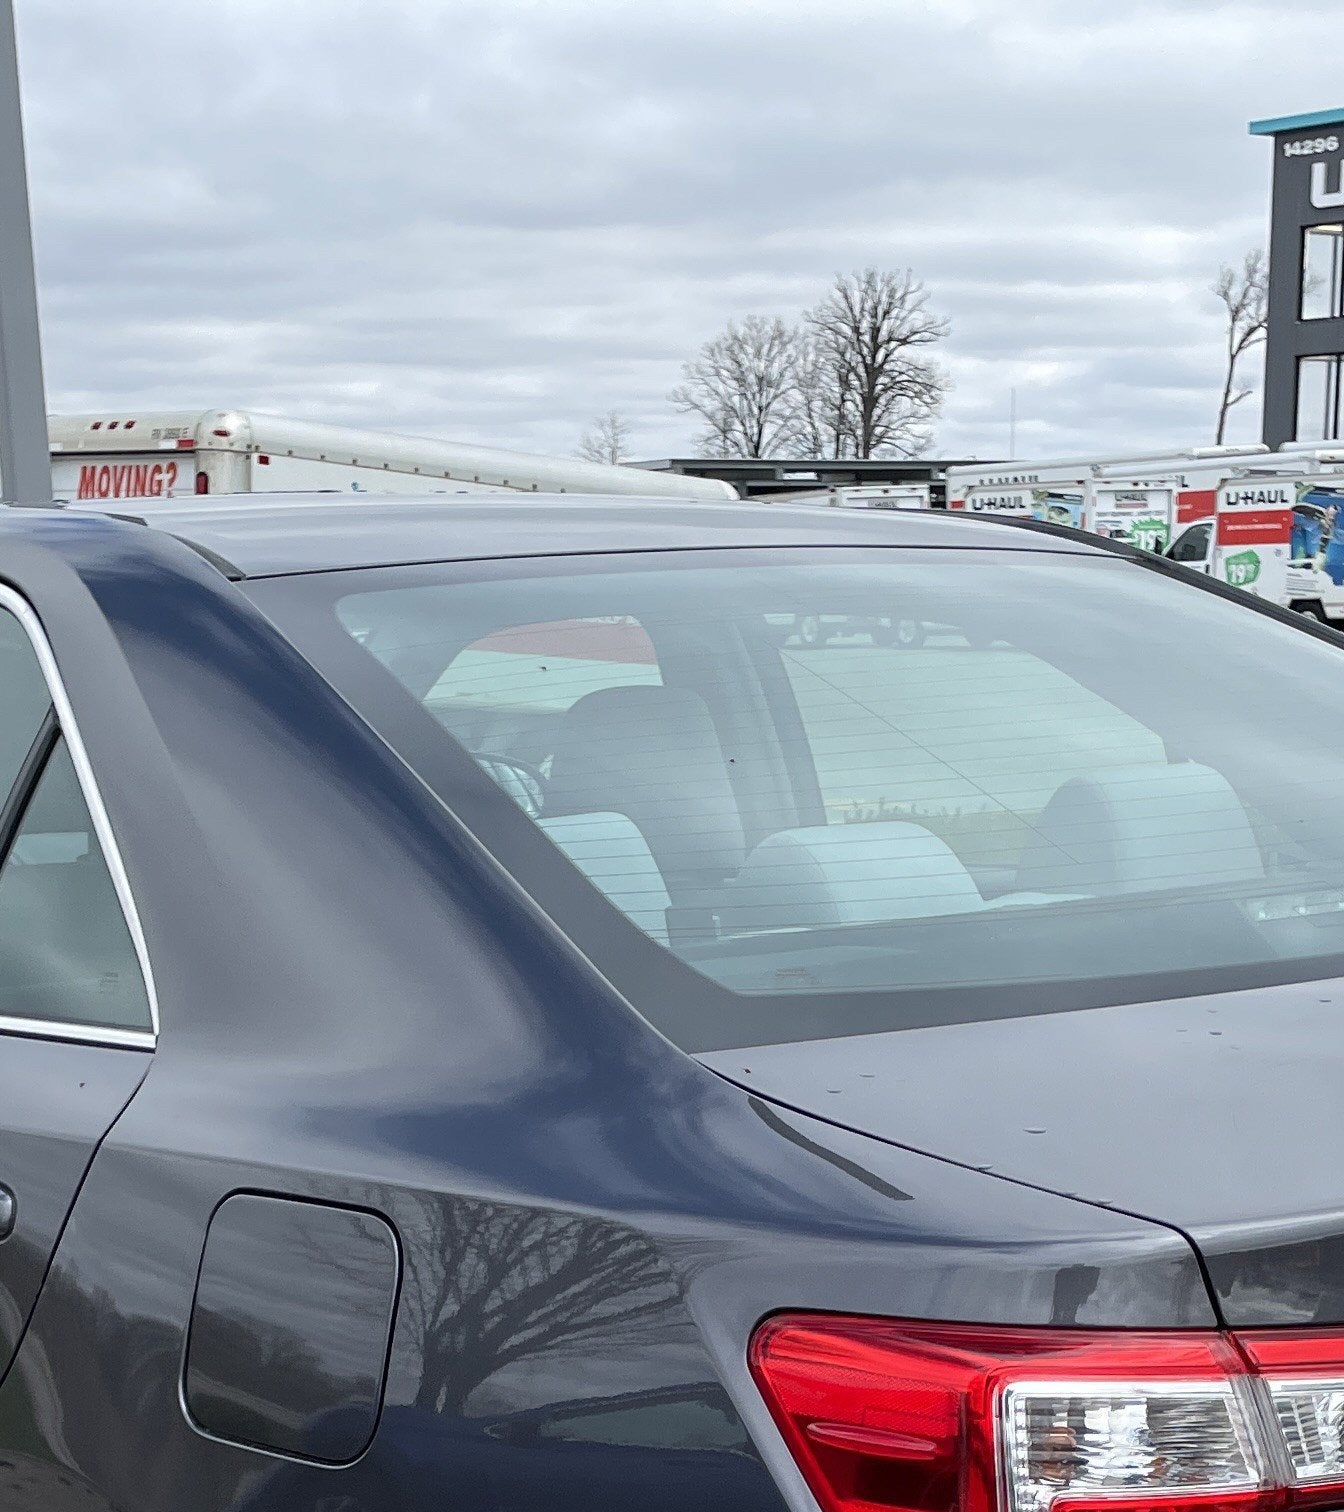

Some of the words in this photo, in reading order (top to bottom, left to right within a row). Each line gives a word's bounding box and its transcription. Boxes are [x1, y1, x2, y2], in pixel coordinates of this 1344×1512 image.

[1283, 135, 1339, 157] 14296
[77, 461, 178, 499] MOVING?
[1225, 489, 1288, 506] U-HAUL
